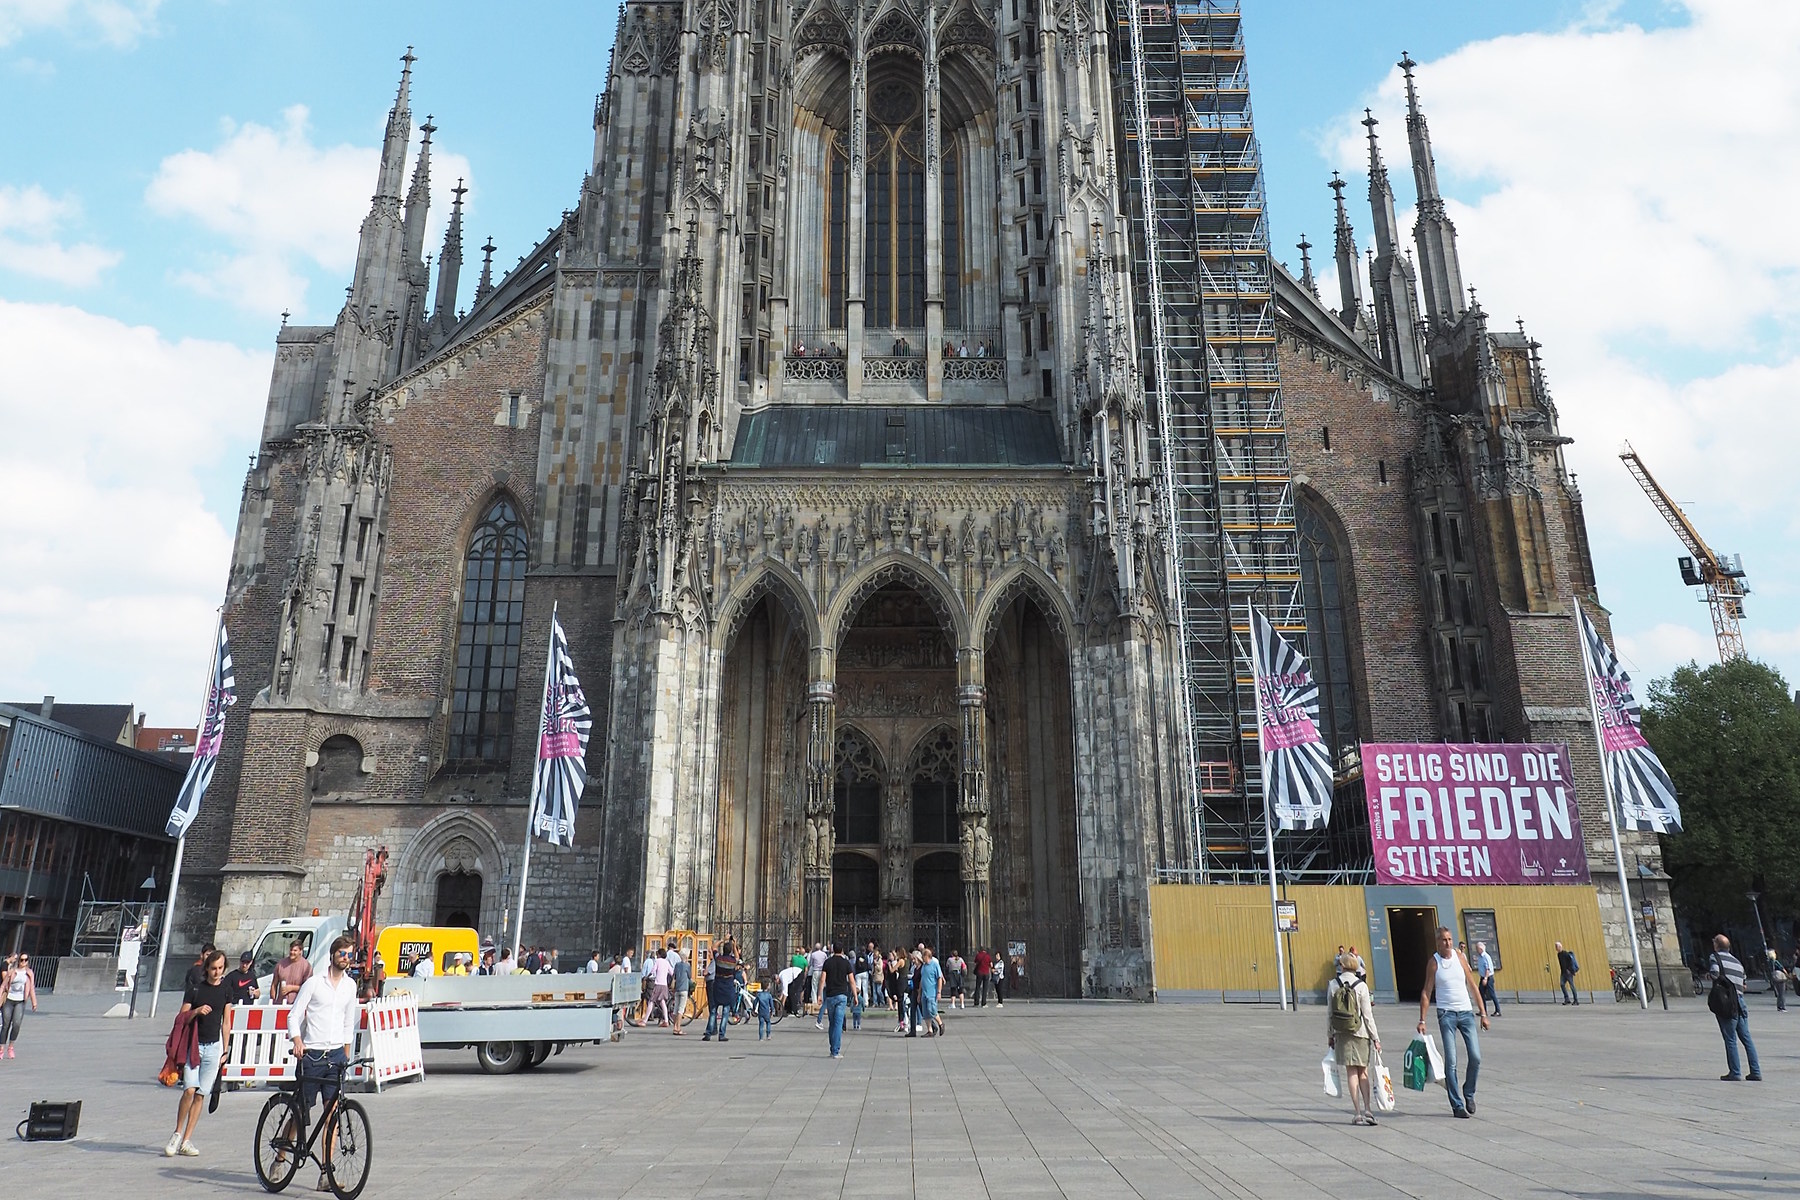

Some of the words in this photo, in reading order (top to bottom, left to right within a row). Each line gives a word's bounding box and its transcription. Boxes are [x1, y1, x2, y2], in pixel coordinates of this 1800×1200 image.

[1267, 704, 1308, 726] BURG
[1376, 753, 1443, 782] SELIG
[1449, 753, 1516, 786] SIND,
[1522, 753, 1562, 781] DIE
[1380, 786, 1573, 840] FRIEDEN
[1387, 845, 1492, 877] STIFTEN
